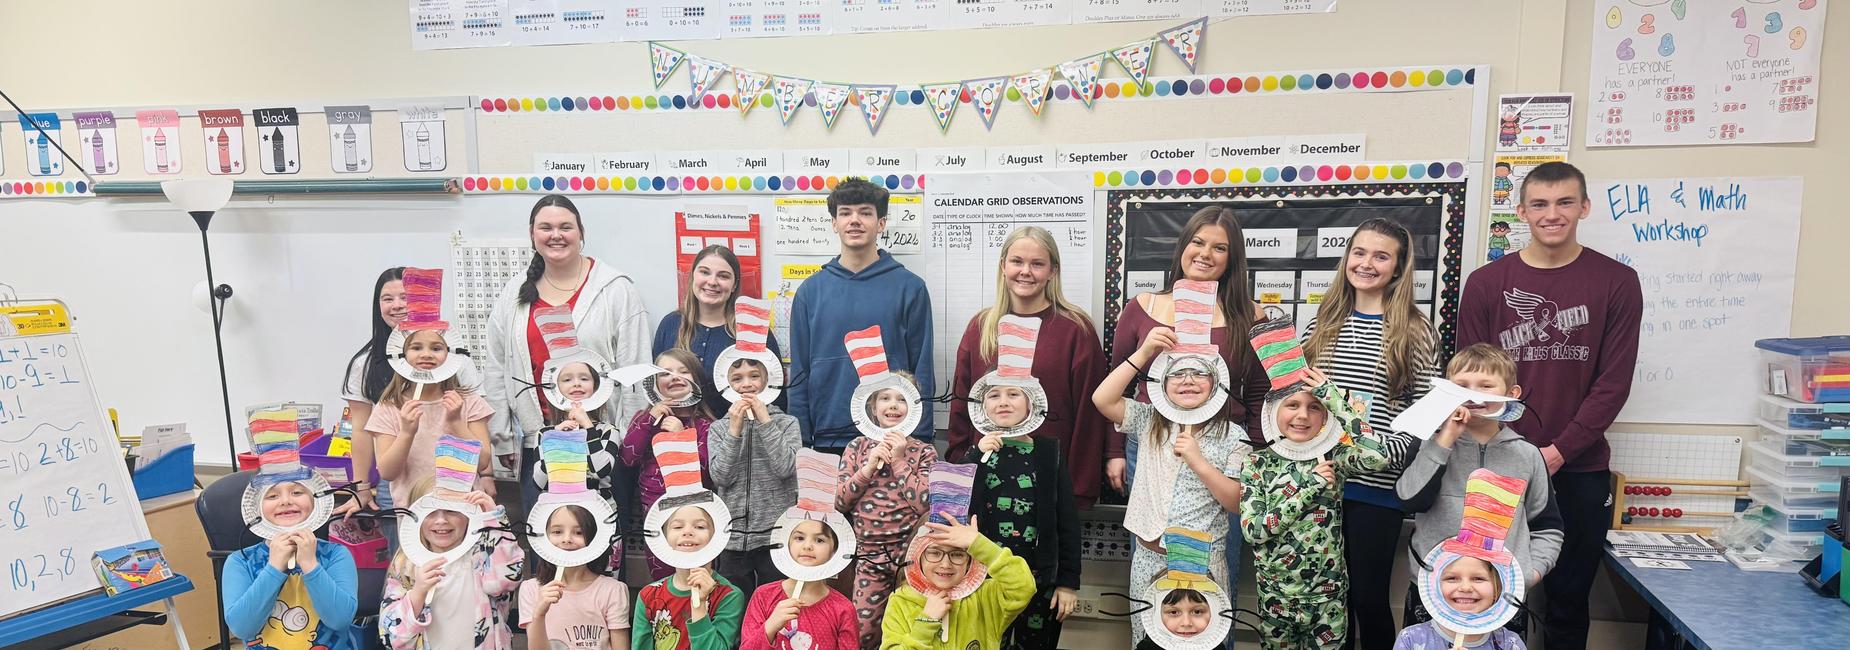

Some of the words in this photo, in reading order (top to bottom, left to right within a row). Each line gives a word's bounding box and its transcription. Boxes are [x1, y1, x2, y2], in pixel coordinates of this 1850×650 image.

[1618, 60, 1673, 76] EVERYONE
[1726, 59, 1746, 72] NOT
[1751, 57, 1791, 71] everyone
[1604, 76, 1624, 89] has
[1628, 79, 1636, 88] a
[1637, 72, 1676, 92] partner!
[1730, 71, 1747, 82] has
[1750, 72, 1757, 80] a
[79, 114, 111, 128] purple
[148, 114, 169, 126] pink
[204, 112, 239, 125] brown
[261, 111, 291, 124] black
[335, 111, 361, 123] gray
[1150, 148, 1195, 160] October
[1221, 145, 1281, 157] November
[1300, 142, 1361, 155] December
[679, 158, 708, 168] March
[744, 157, 767, 169] April
[810, 157, 830, 168] May
[877, 156, 900, 166] June
[946, 156, 967, 168] July
[1006, 154, 1044, 167] August
[1068, 151, 1128, 165] September
[551, 160, 585, 172] January
[609, 159, 650, 171] February
[934, 198, 984, 207] CALENDAR
[986, 197, 1010, 207] GRID
[1012, 196, 1084, 206] OBSERVATIONS
[1607, 183, 1651, 222] ELA
[1670, 180, 1687, 209] &
[1698, 183, 1748, 213] Math
[1632, 217, 1709, 248] Workshop
[1245, 237, 1281, 248] March
[1666, 271, 1703, 286] started
[1134, 281, 1156, 290] Sunday
[1256, 281, 1293, 289] Wednesday
[1720, 294, 1745, 308] time
[1679, 318, 1697, 331] one
[1551, 345, 1589, 362] CLASSIC
[564, 628, 572, 642] I
[573, 624, 605, 640] DONUT
